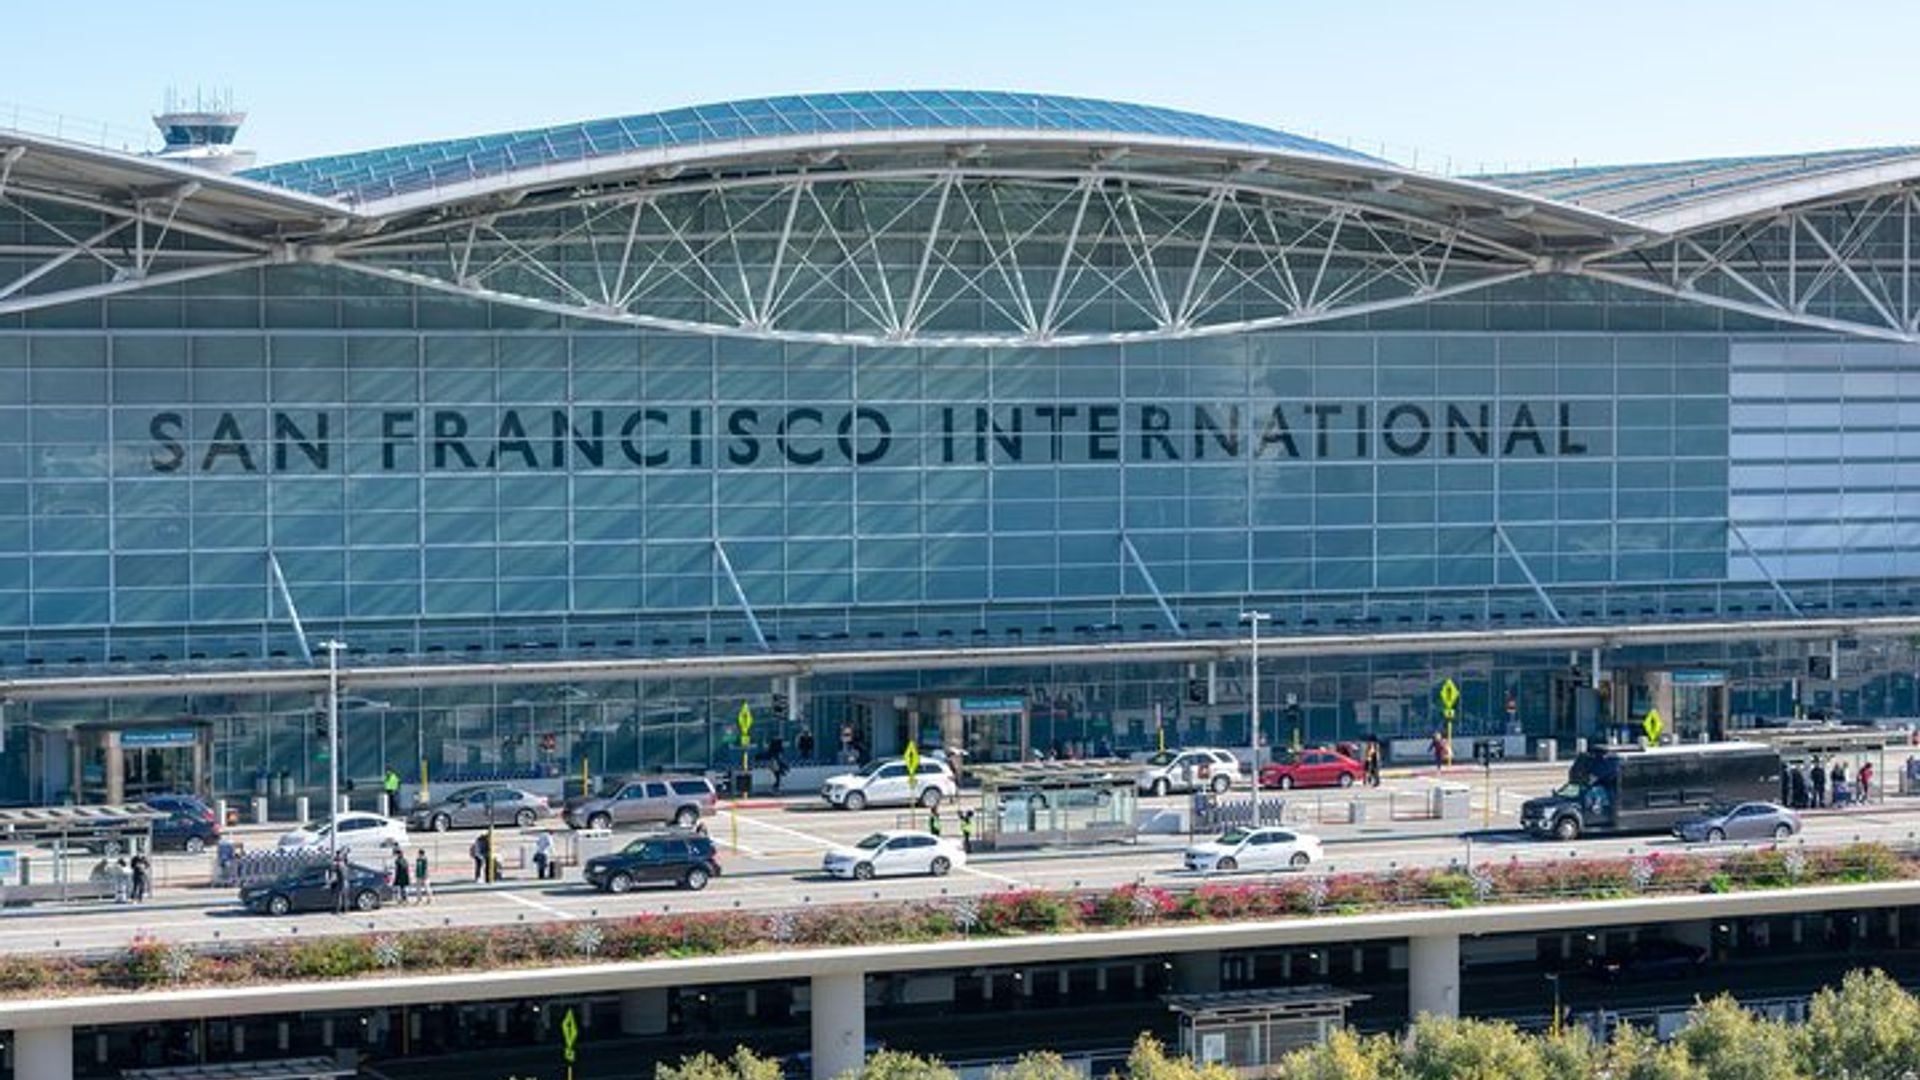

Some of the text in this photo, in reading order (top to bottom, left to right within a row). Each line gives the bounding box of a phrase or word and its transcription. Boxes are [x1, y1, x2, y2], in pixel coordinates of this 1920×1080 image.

[149, 402, 1588, 472] SAN FRANCISCO INTERNATIONAL
